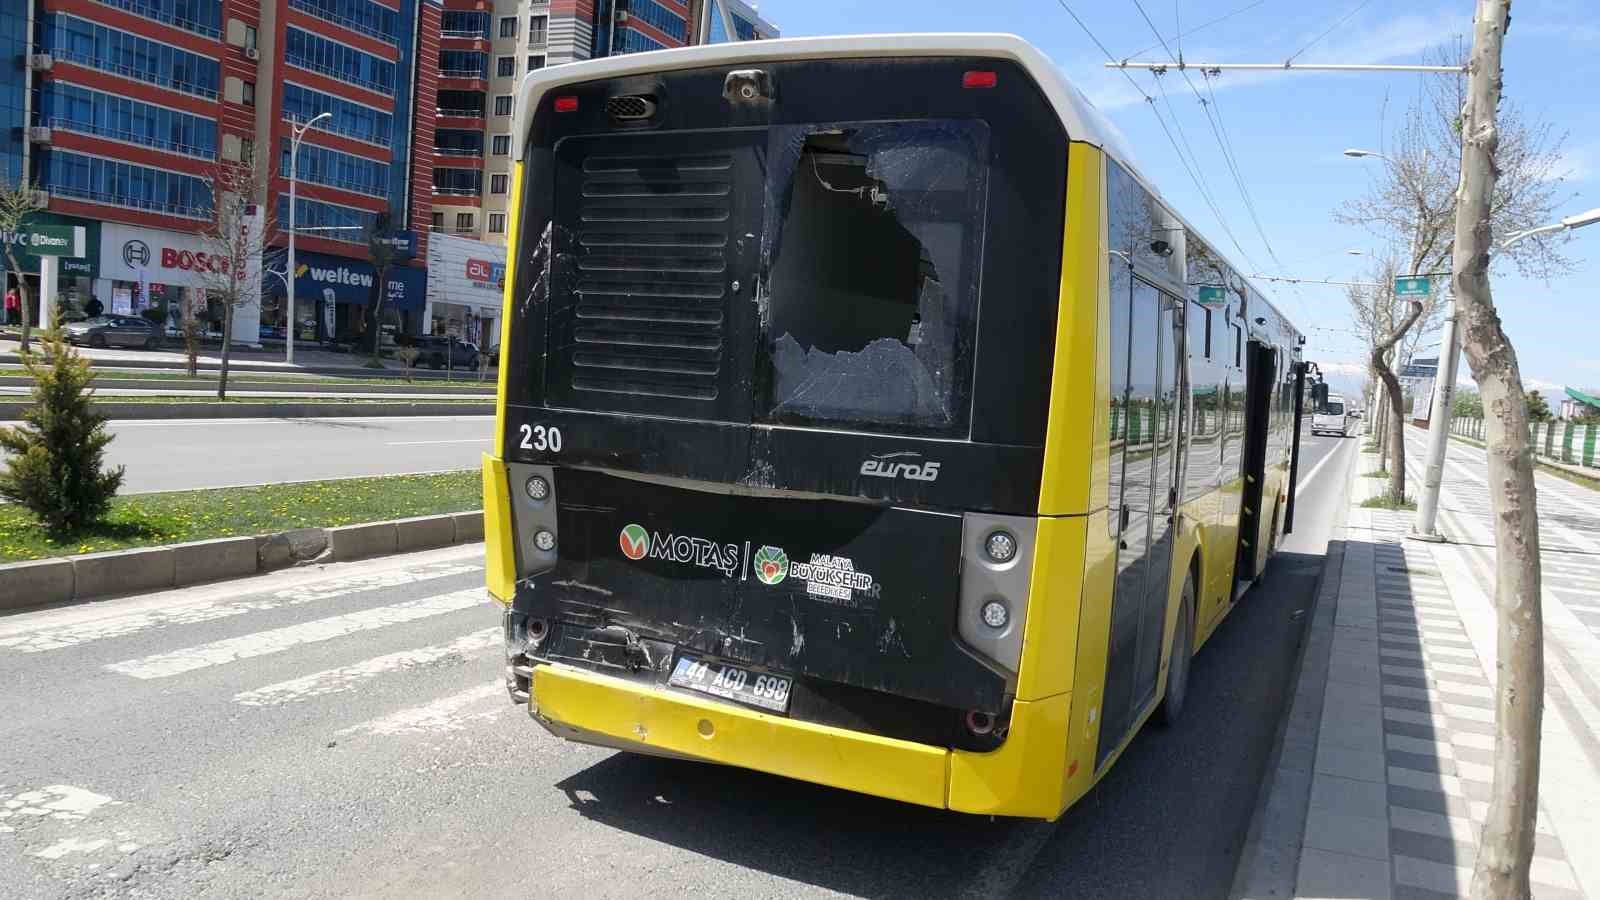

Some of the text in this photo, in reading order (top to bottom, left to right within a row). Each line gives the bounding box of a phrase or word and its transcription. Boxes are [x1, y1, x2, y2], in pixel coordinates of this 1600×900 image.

[310, 266, 373, 288] weltew
[520, 424, 562, 452] 230
[860, 460, 940, 481] euro6
[650, 531, 738, 577] MOTAŞ
[810, 553, 854, 571] MALATYA
[686, 660, 709, 680] 44
[711, 666, 748, 691] ACD
[753, 674, 789, 701] 698
